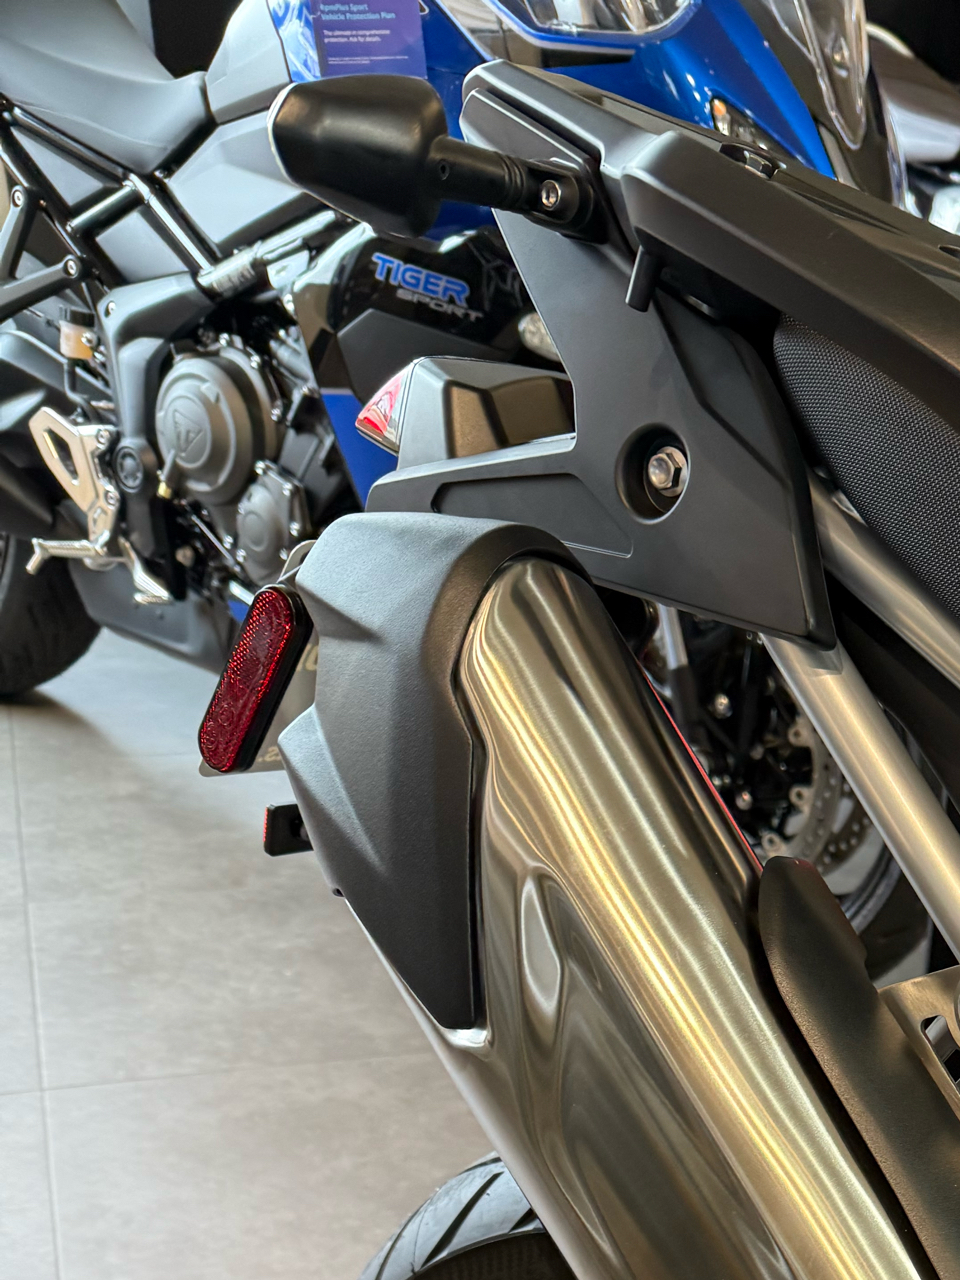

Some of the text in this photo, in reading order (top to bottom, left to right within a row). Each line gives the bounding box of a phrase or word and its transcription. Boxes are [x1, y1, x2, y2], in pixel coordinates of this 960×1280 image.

[321, 11, 396, 20] Vehicle Protection Plan
[371, 252, 470, 308] TIGER
[396, 287, 484, 322] SPORT
